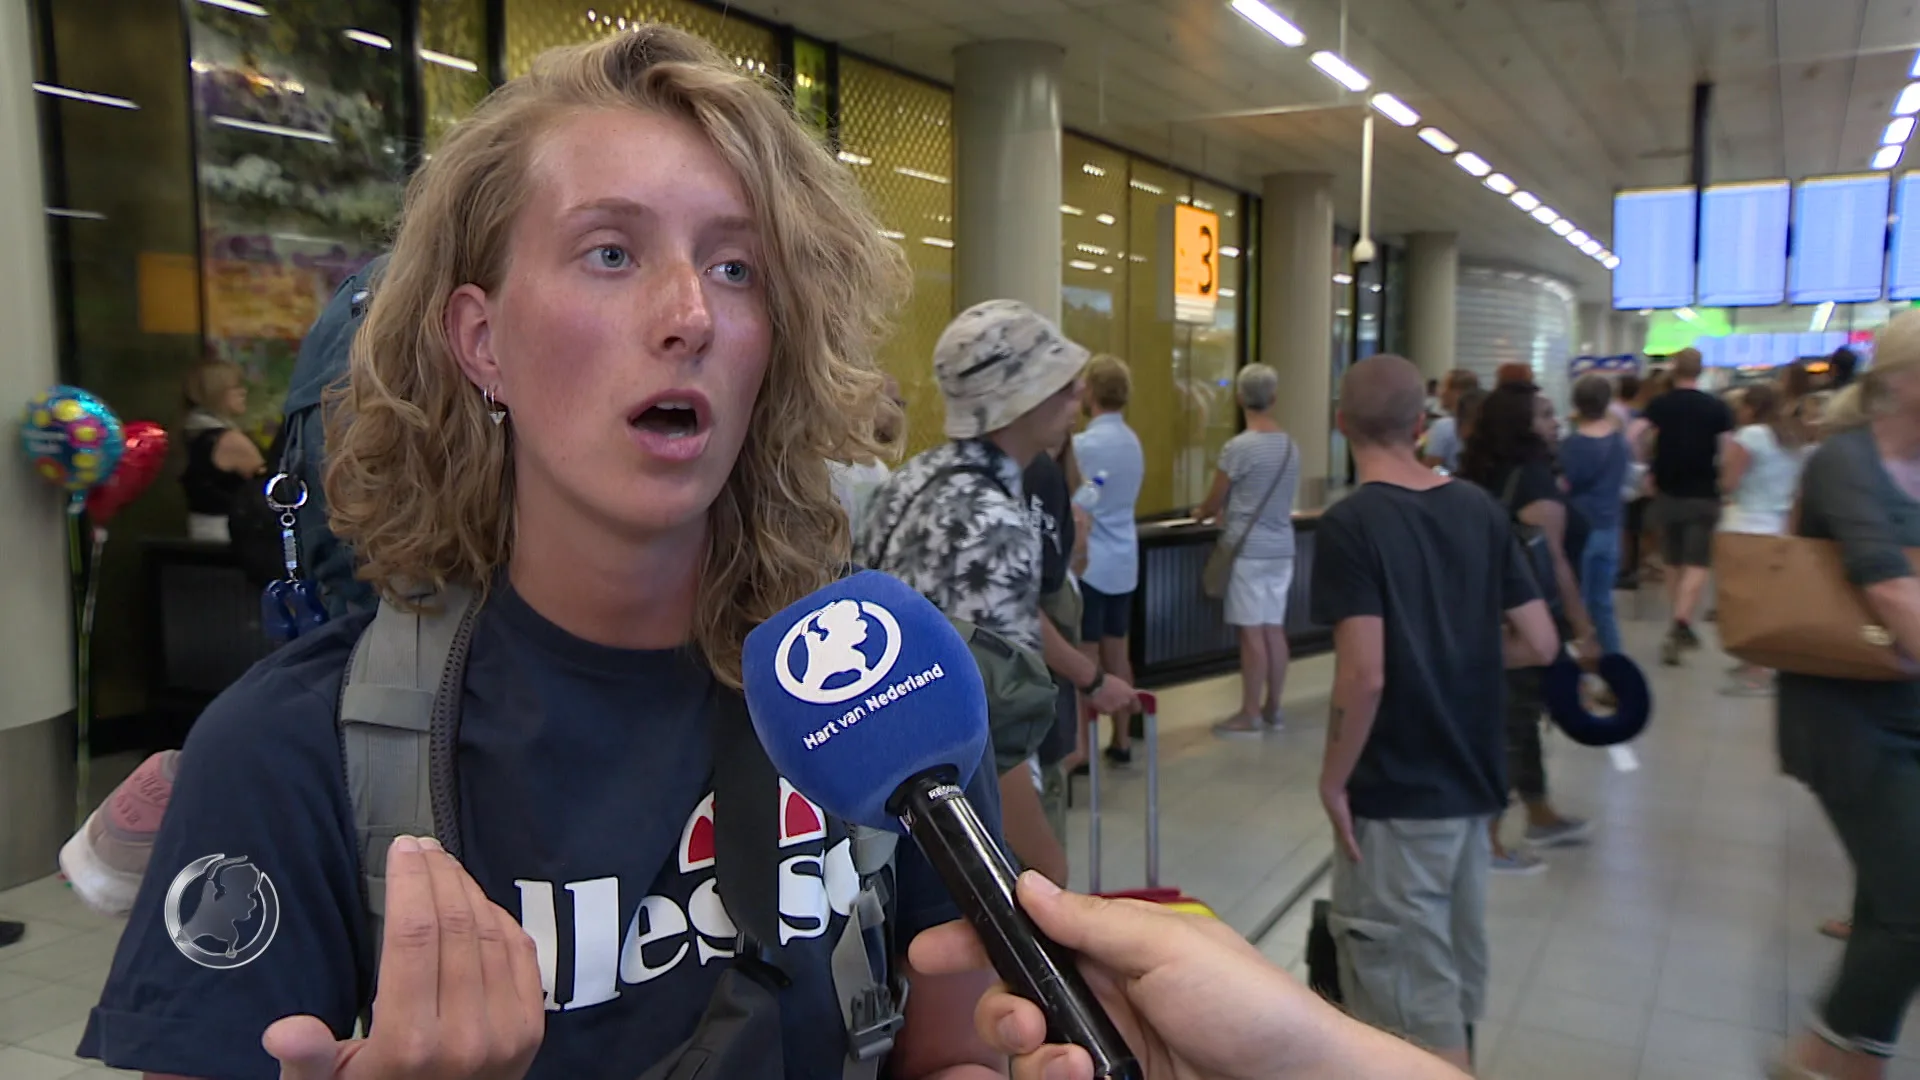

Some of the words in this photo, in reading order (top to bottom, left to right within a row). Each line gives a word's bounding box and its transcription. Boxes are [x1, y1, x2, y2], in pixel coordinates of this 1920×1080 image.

[1199, 225, 1213, 296] 3
[803, 720, 839, 750] Hart
[837, 705, 867, 728] van
[865, 662, 945, 712] Nederland
